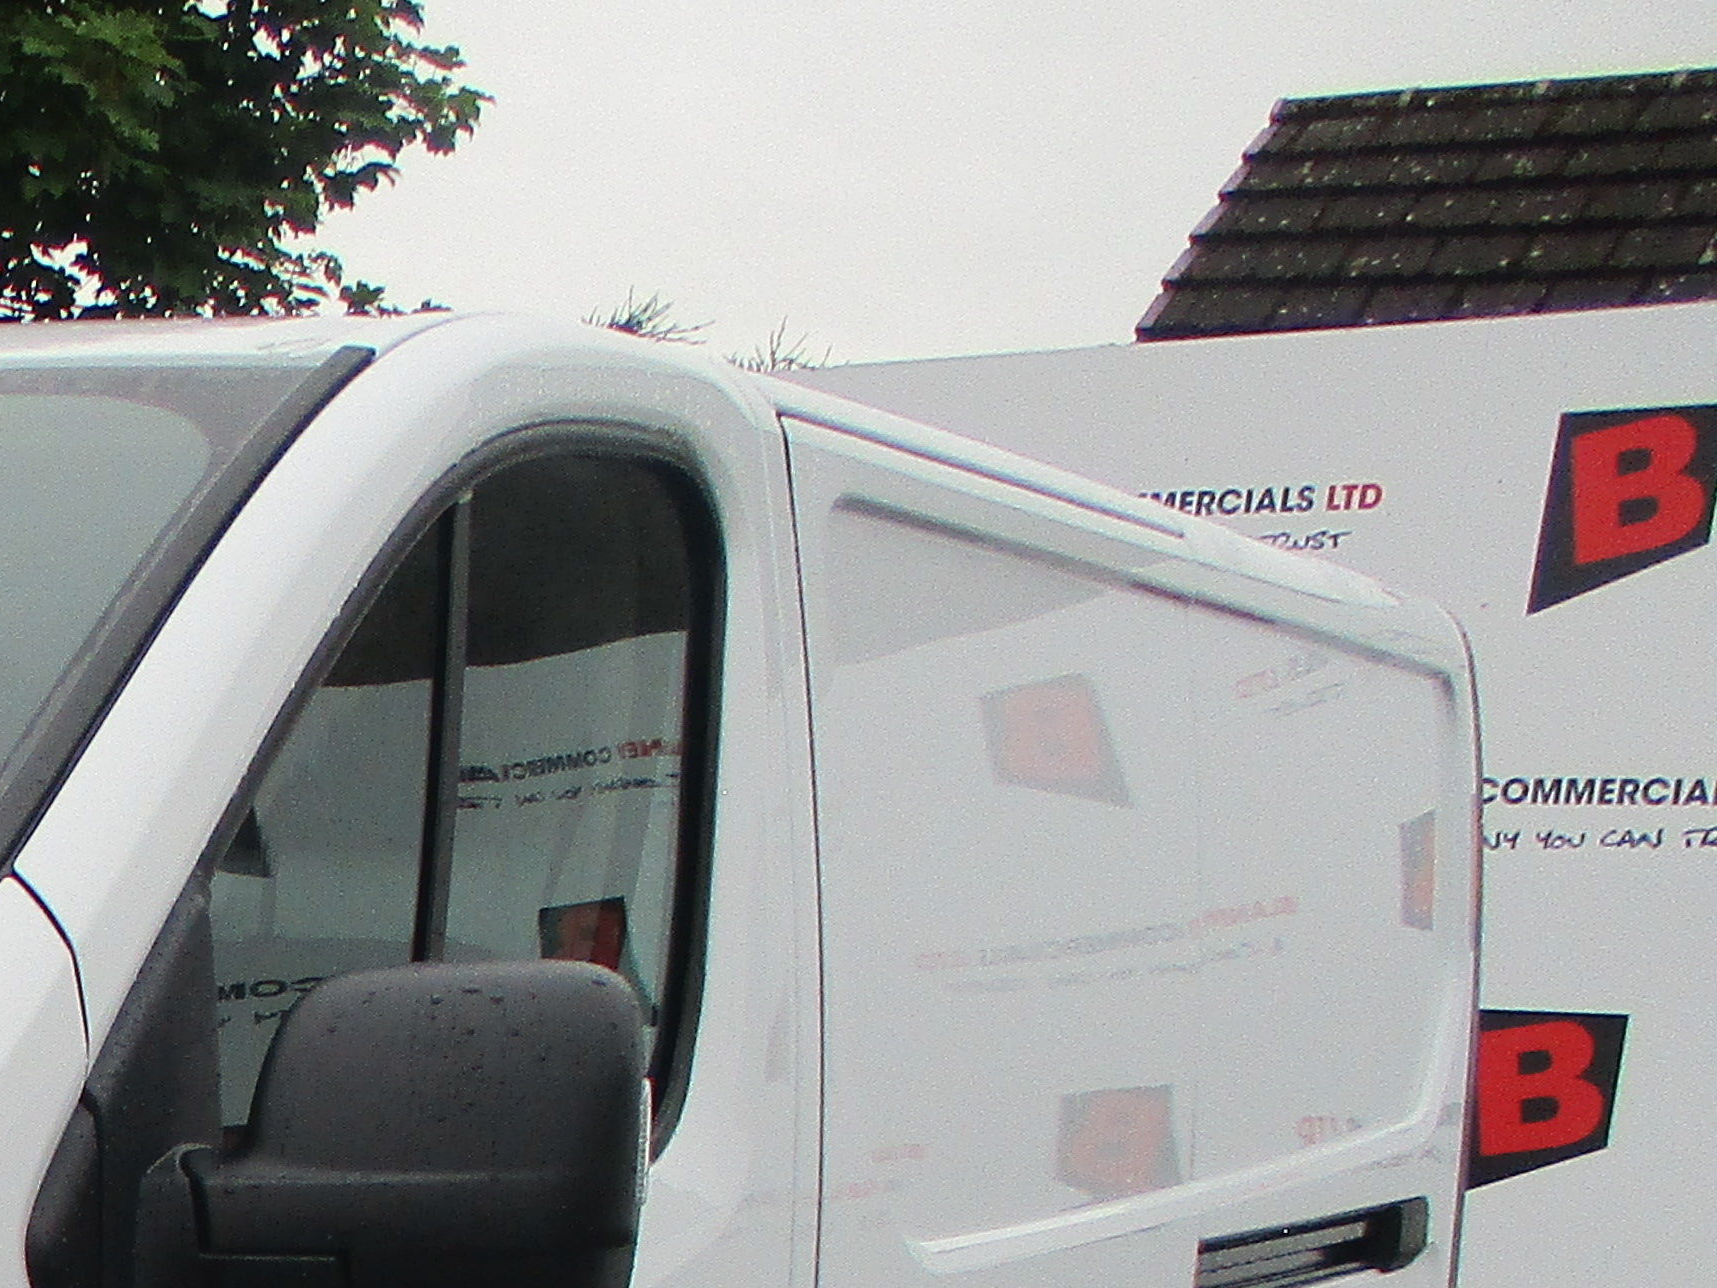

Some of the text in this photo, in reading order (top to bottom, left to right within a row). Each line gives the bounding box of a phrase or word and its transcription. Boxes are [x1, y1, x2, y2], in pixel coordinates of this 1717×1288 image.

[1325, 483, 1383, 512] LTD
[1572, 415, 1705, 566] B
[1481, 777, 1717, 805] COMMERCIA
[1536, 828, 1586, 850] YOU
[1599, 827, 1664, 849] CAN
[1479, 1021, 1604, 1157] B
